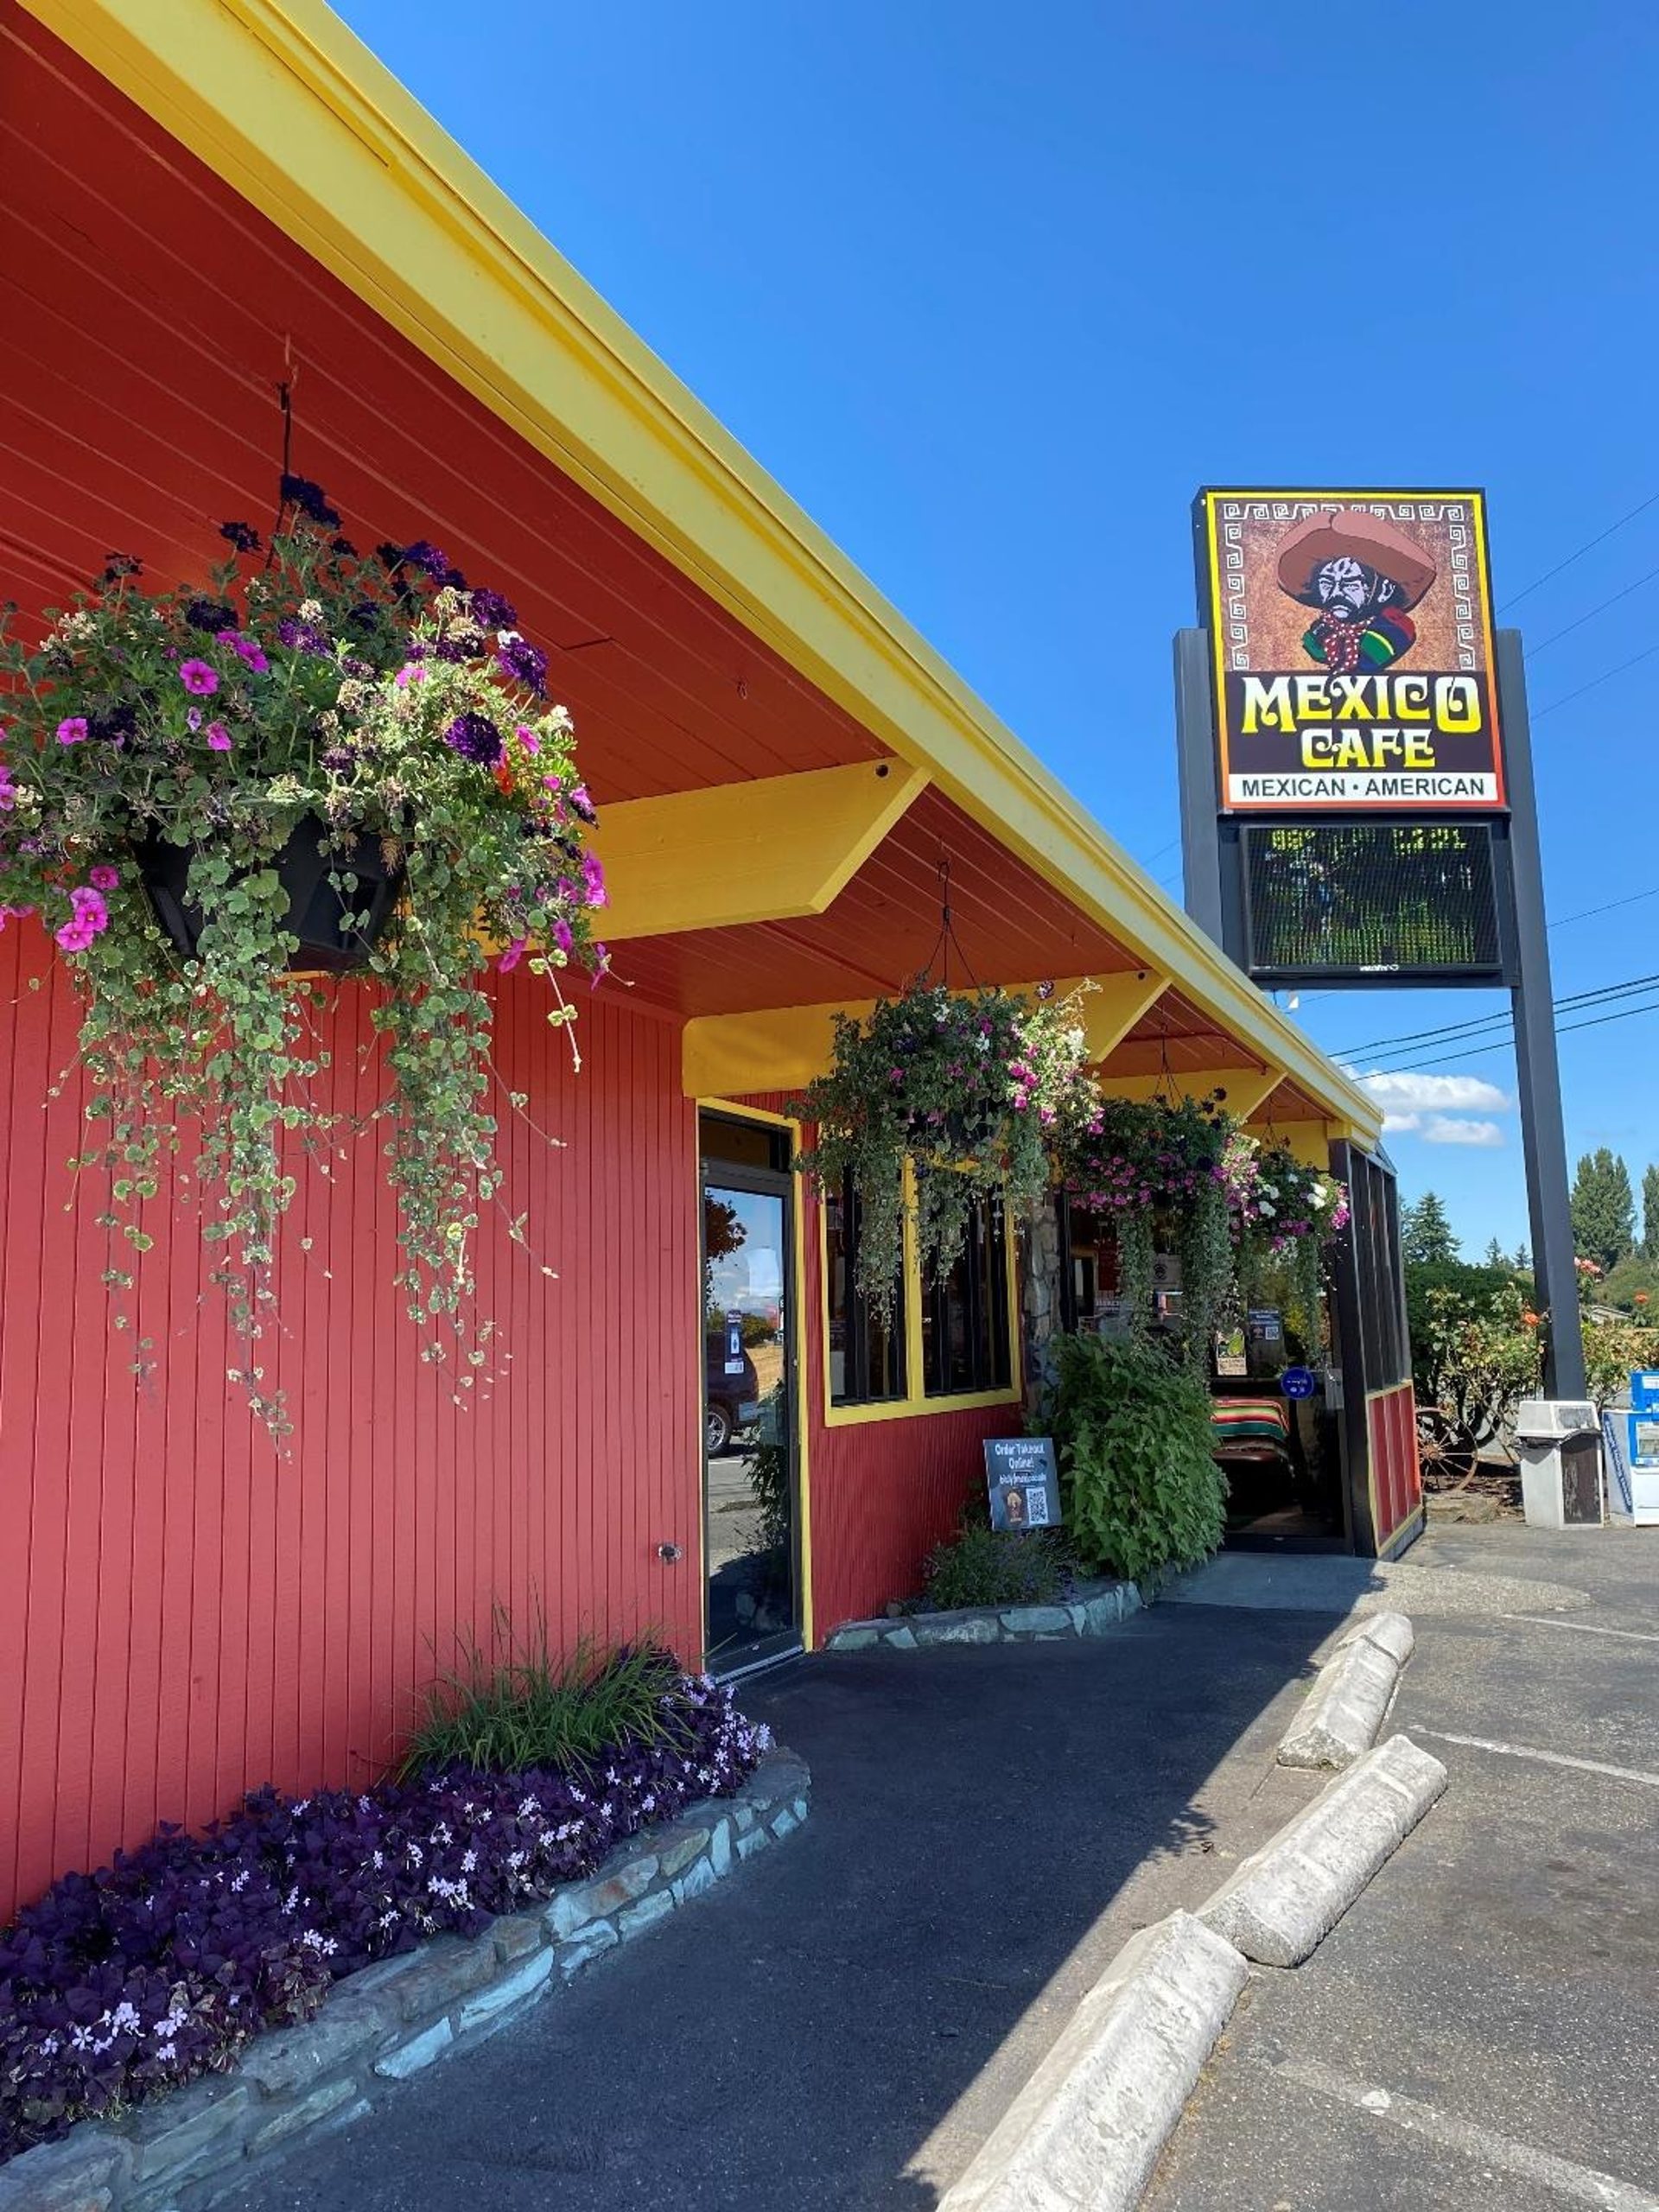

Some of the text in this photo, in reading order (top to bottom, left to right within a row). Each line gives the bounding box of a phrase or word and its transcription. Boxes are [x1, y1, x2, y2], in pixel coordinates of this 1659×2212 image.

[1241, 673, 1482, 734] MEXICO
[1301, 728, 1436, 768] CAFE
[1242, 777, 1484, 797] MEXICAN AMERICAN
[995, 1443, 1015, 1455] Order
